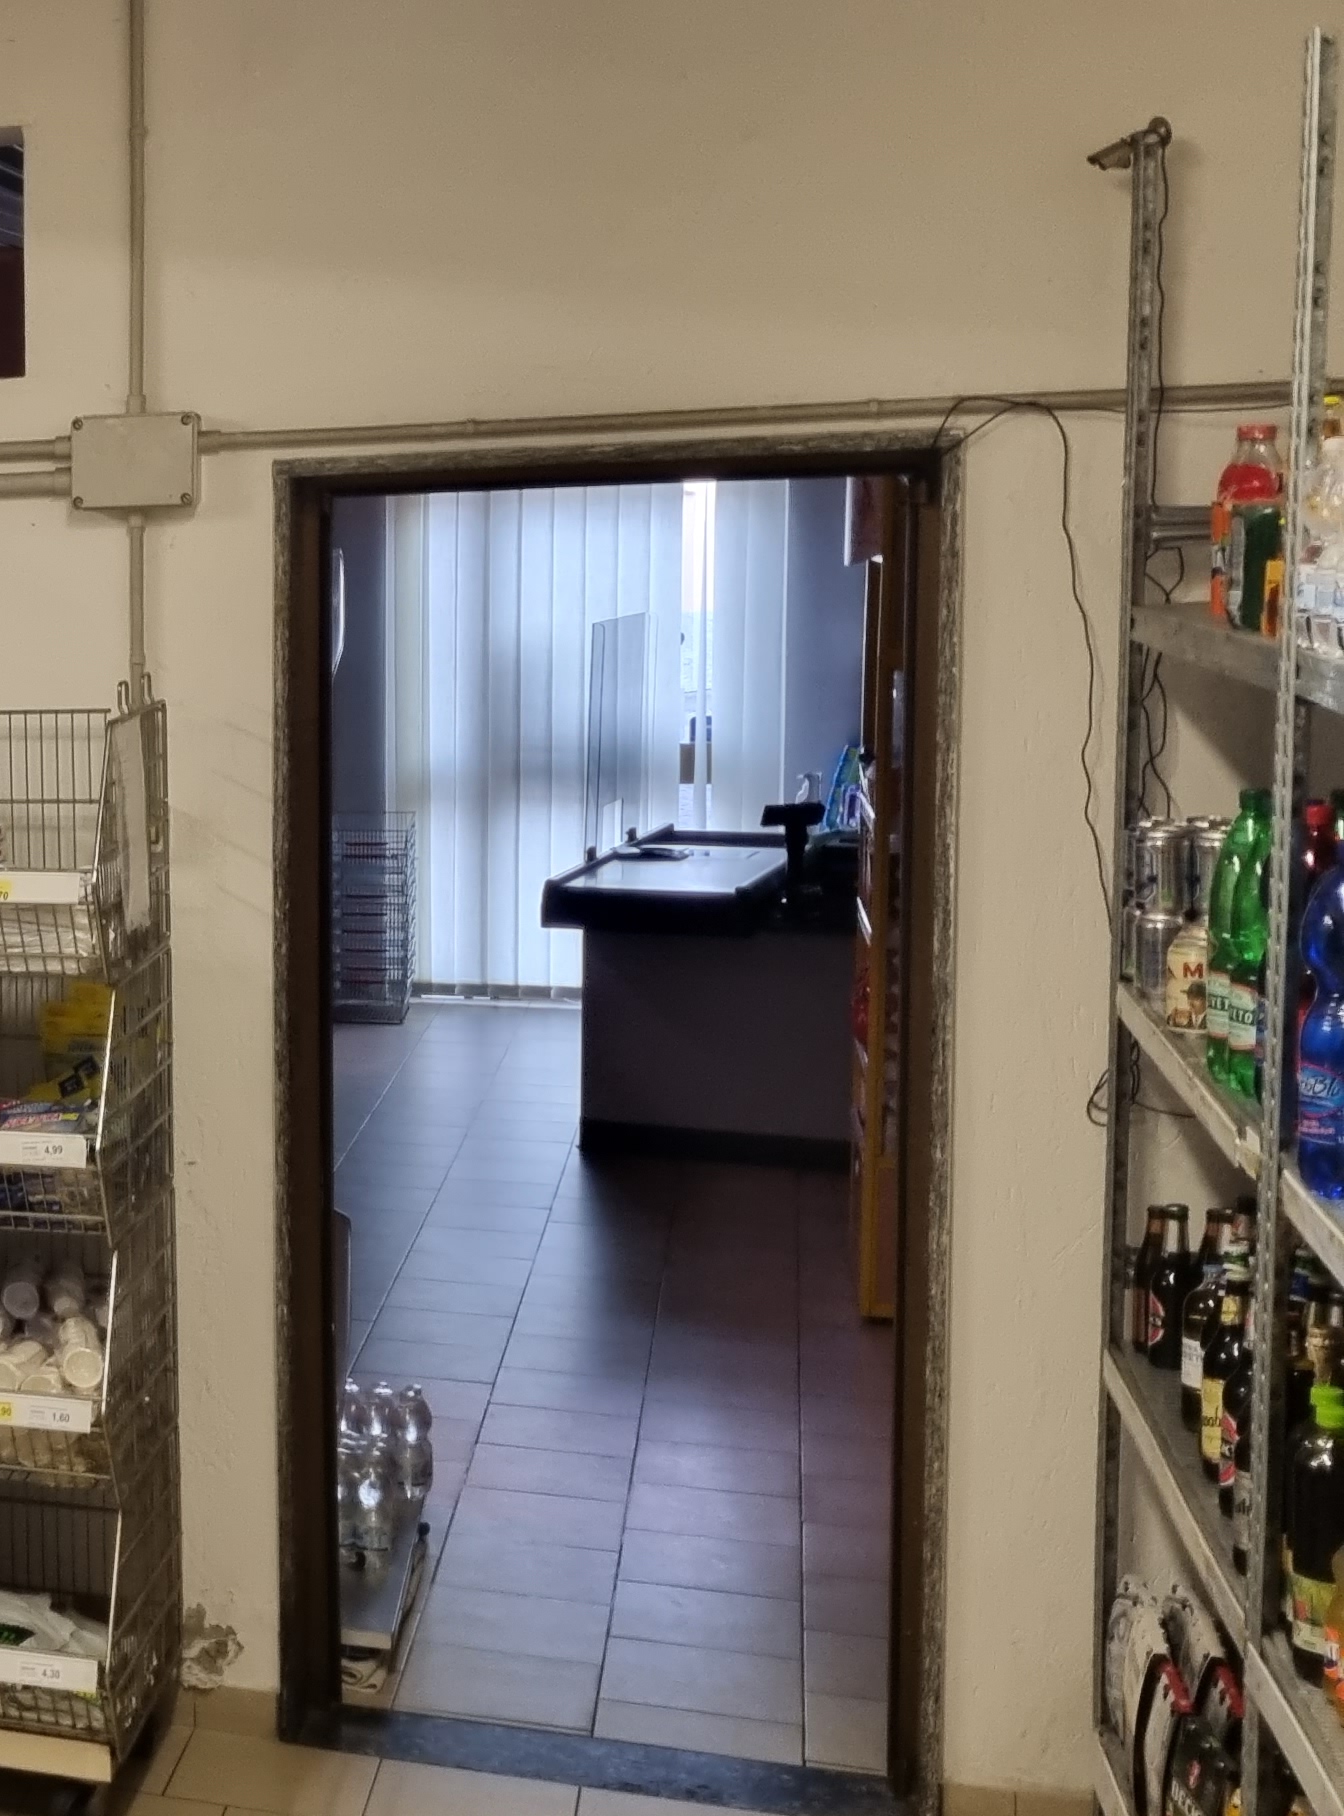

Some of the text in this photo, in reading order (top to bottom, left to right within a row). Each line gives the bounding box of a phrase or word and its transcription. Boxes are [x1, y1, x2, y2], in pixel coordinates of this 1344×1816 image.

[44, 1145, 63, 1156] 4,99
[51, 1412, 70, 1423] 1,60
[41, 1668, 60, 1681] 4,30
